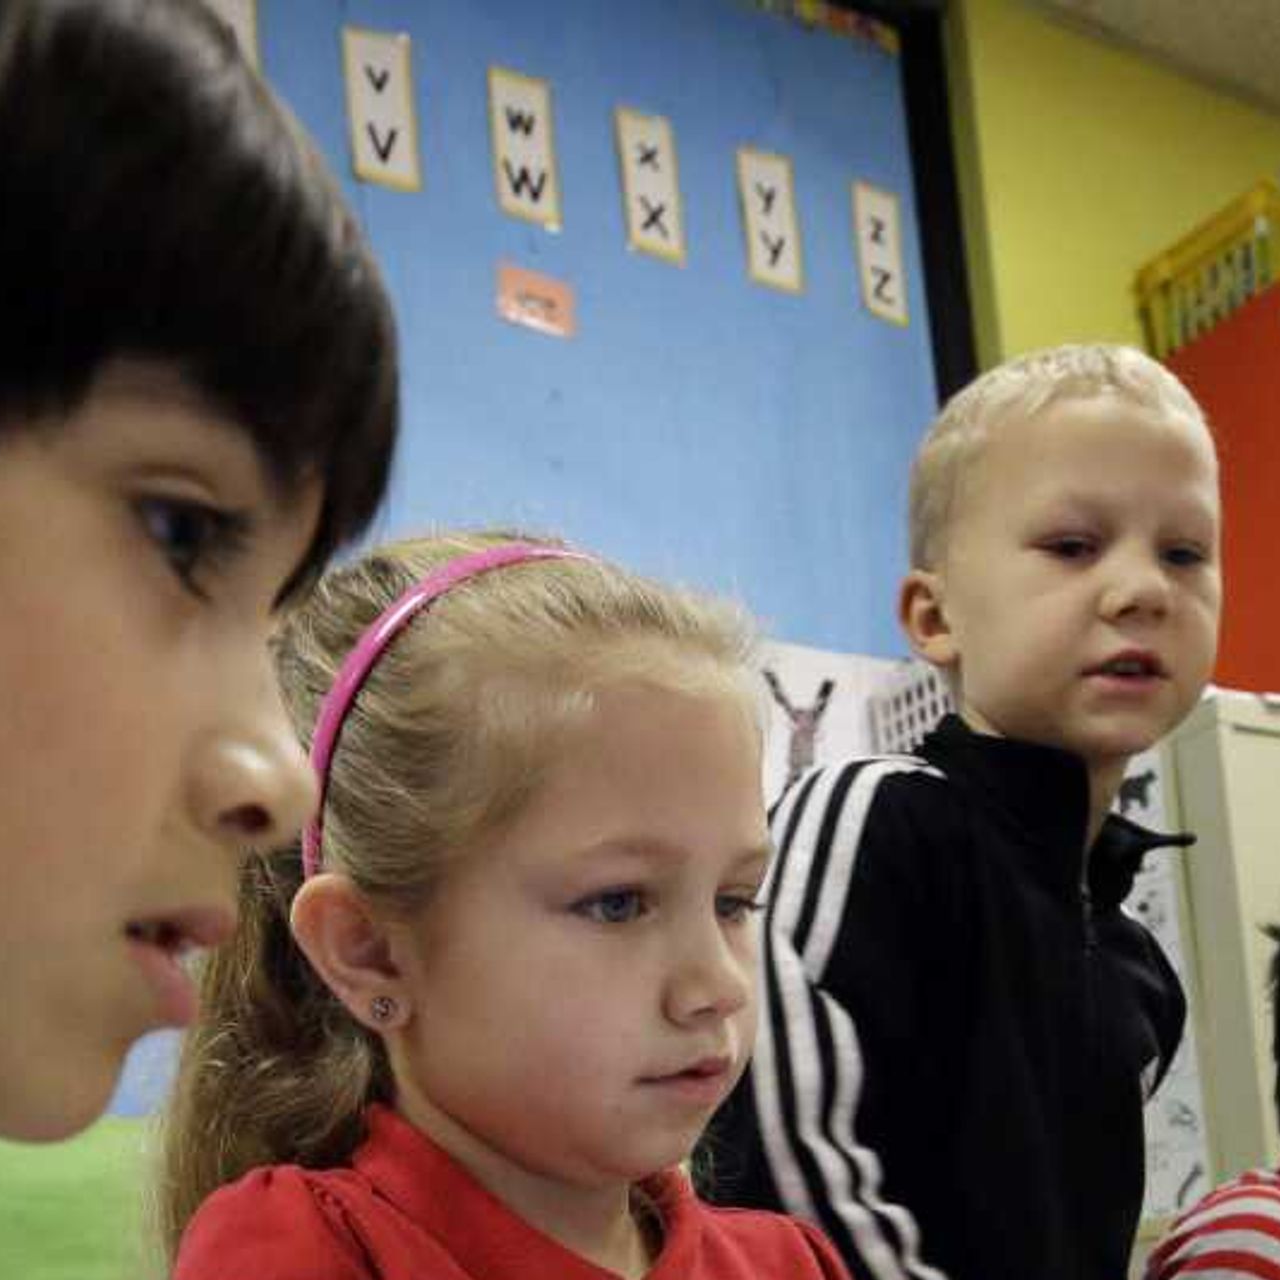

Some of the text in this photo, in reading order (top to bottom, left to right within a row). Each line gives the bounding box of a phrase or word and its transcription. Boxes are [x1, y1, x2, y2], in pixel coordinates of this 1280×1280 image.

[367, 121, 397, 165] V
[502, 157, 547, 203] W
[639, 196, 669, 239] X
[870, 265, 896, 305] Z
